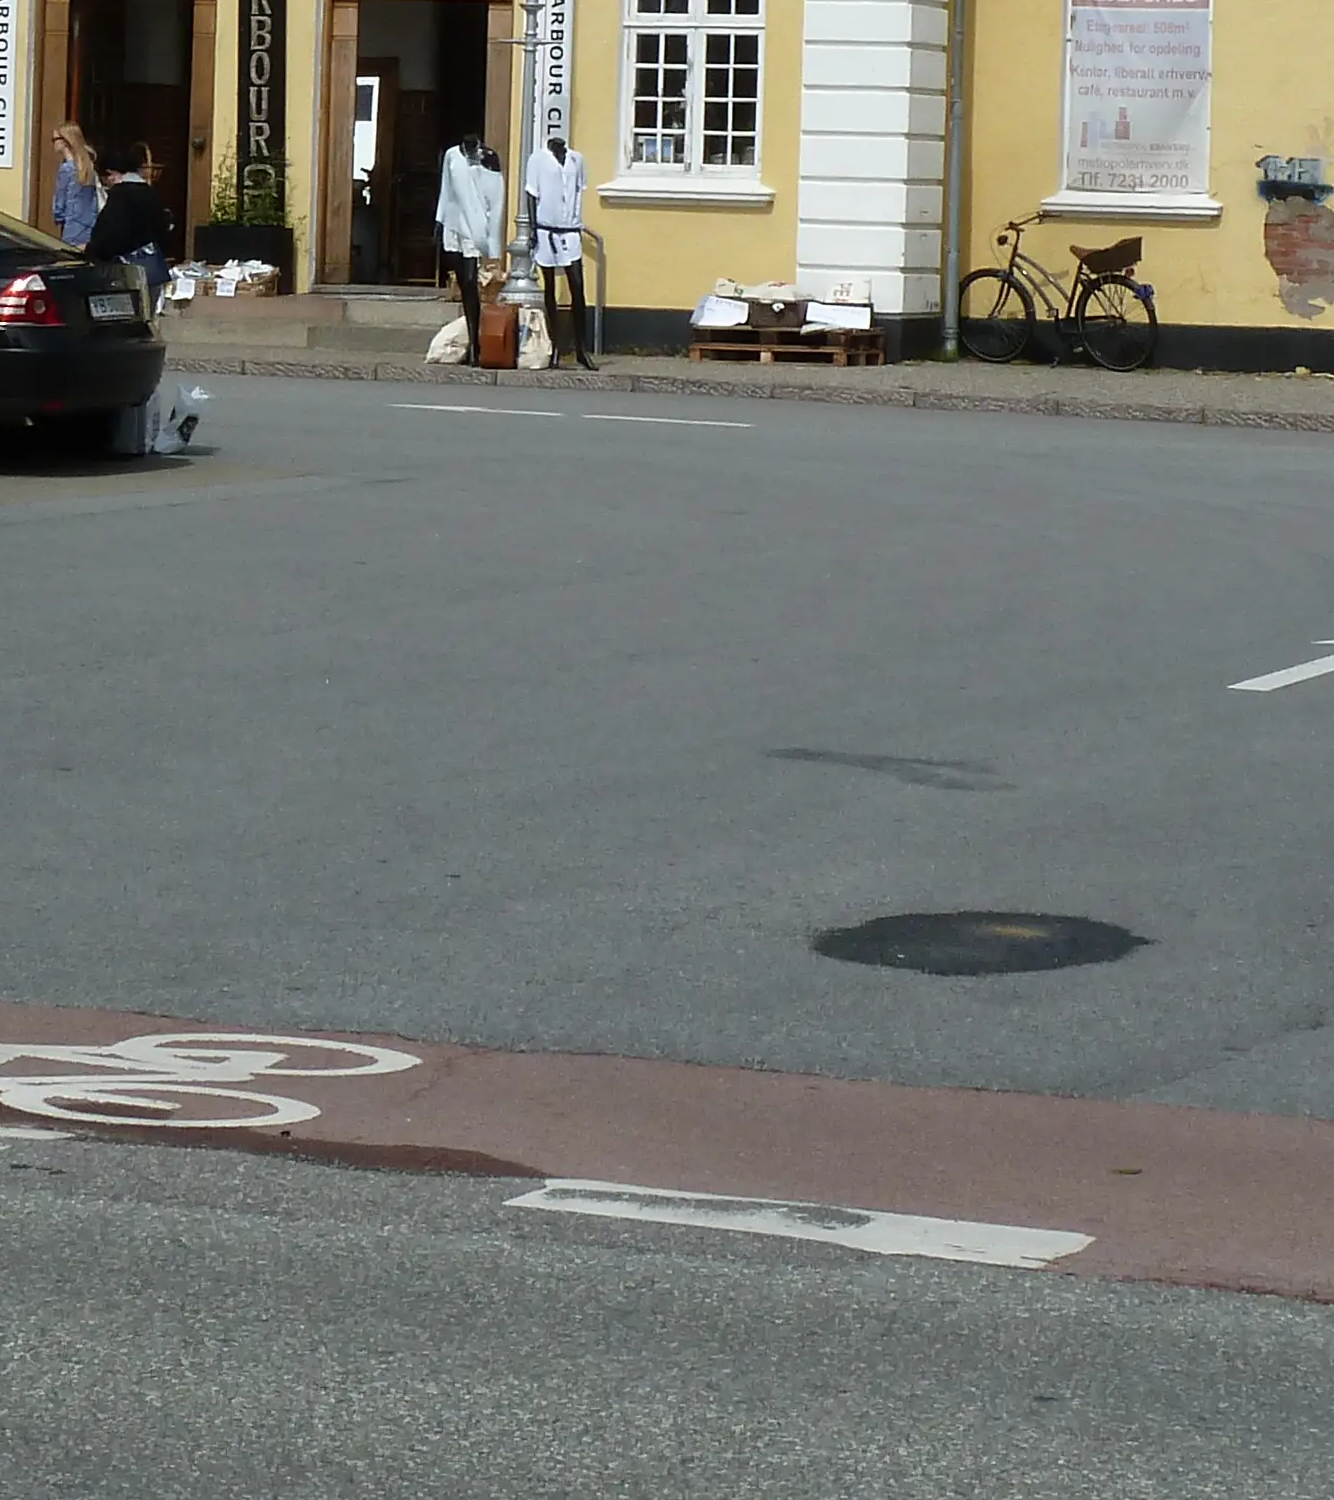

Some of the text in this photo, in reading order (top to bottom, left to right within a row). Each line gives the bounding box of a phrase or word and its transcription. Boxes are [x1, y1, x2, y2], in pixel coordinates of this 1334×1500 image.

[1129, 41, 1145, 52] for
[1150, 42, 1201, 57] opdeling
[1115, 66, 1155, 79] liberalt
[1108, 86, 1168, 98] restaurant
[547, 108, 562, 135] CL
[1080, 172, 1188, 188] Tlf. 7231 2000
